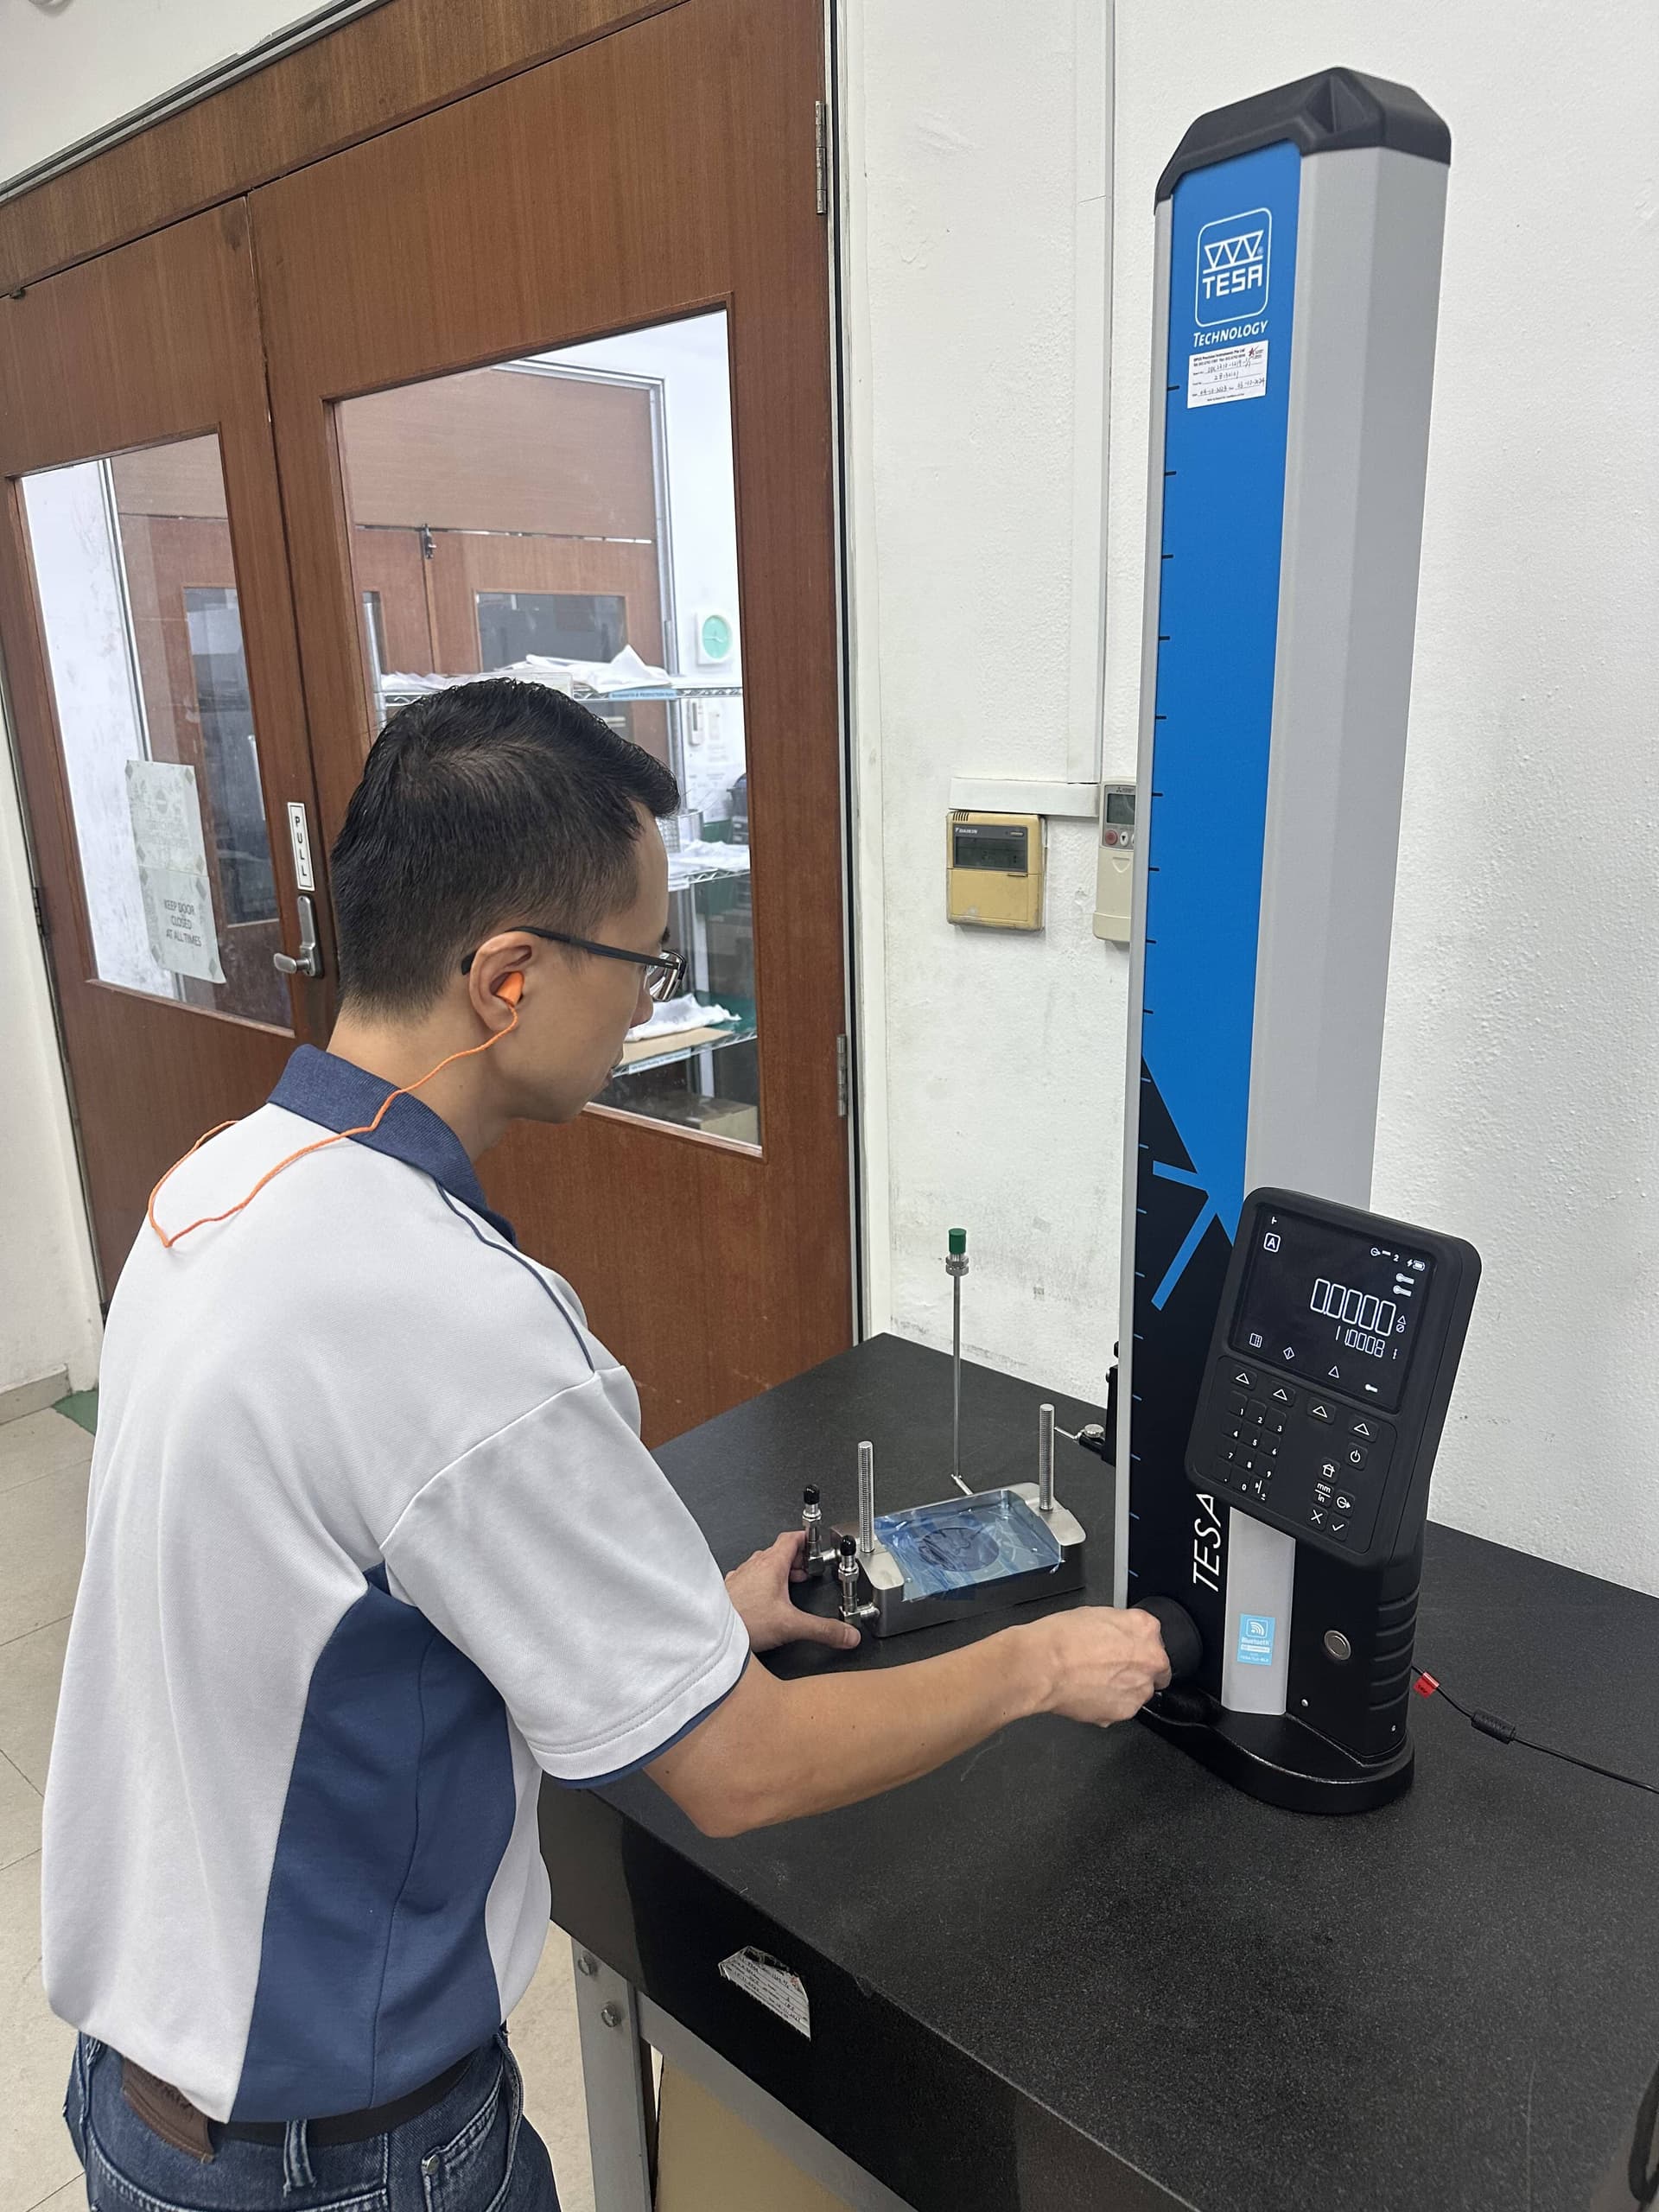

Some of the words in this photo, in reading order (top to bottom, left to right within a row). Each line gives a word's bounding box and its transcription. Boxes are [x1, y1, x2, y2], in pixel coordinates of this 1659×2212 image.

[1202, 264, 1262, 299] TESA
[1193, 320, 1268, 347] TECHNOLOGY
[295, 816, 308, 876] PULL
[164, 899, 177, 911] KEEP
[178, 902, 195, 915] DOOR
[171, 915, 193, 930] CLOSED
[166, 929, 174, 939] AT
[174, 931, 184, 942] ALL
[183, 933, 202, 947] TIMES
[1316, 1483, 1332, 1494] mm
[1318, 1493, 1325, 1503] in
[1193, 1494, 1221, 1592] TESA
